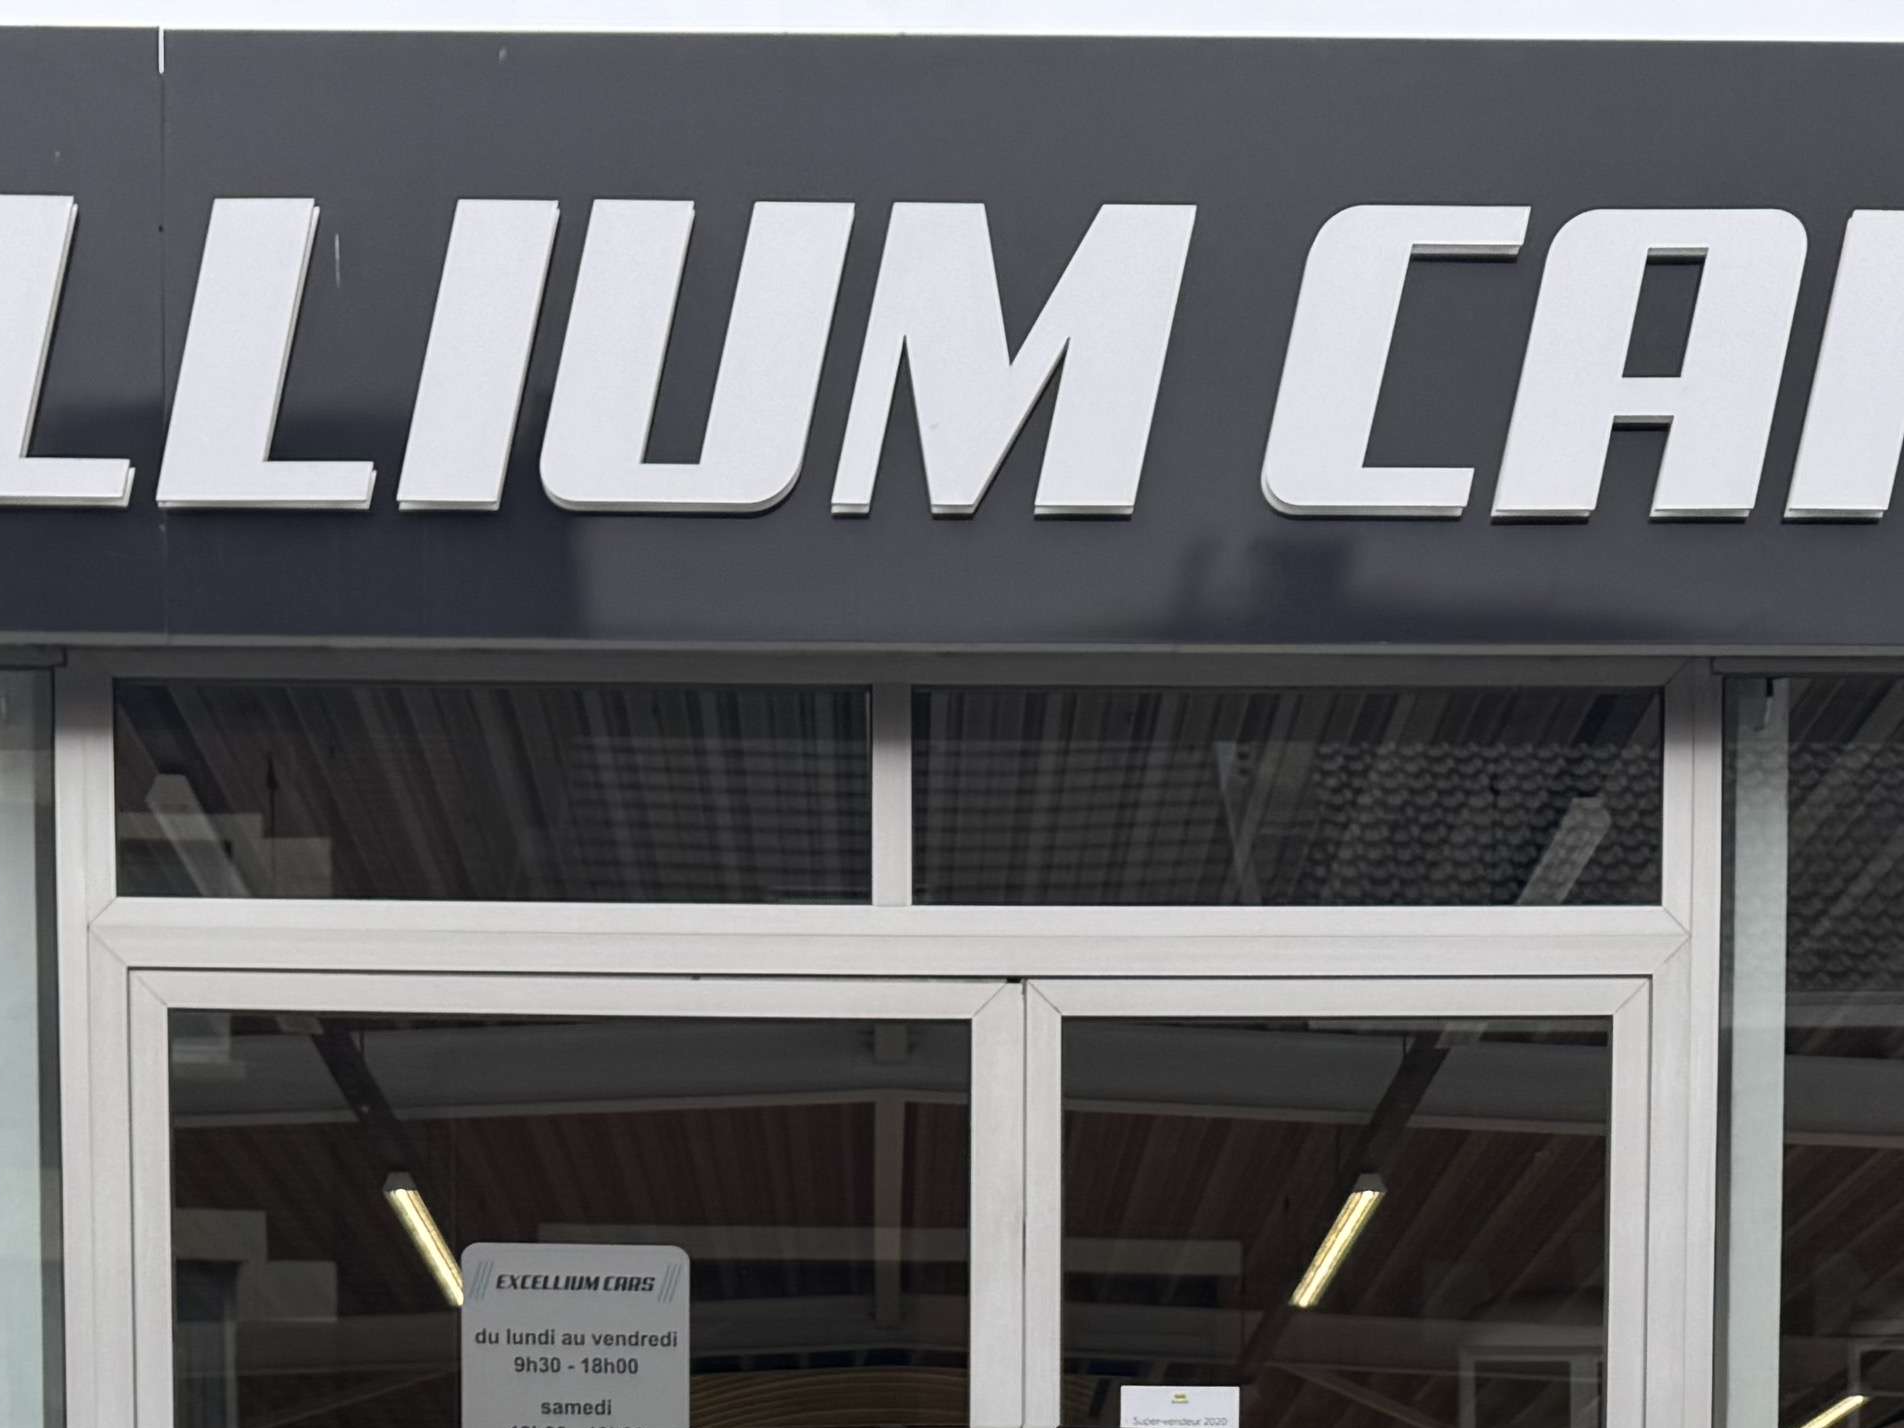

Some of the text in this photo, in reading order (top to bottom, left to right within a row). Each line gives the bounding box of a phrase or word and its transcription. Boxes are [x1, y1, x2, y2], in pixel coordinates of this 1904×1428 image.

[496, 1273, 656, 1293] EXCELLIUM CARS
[475, 1328, 678, 1348] du lundi au vendredi
[513, 1356, 562, 1374] 9h30
[581, 1357, 639, 1375] 18h00
[540, 1399, 612, 1416] samedi
